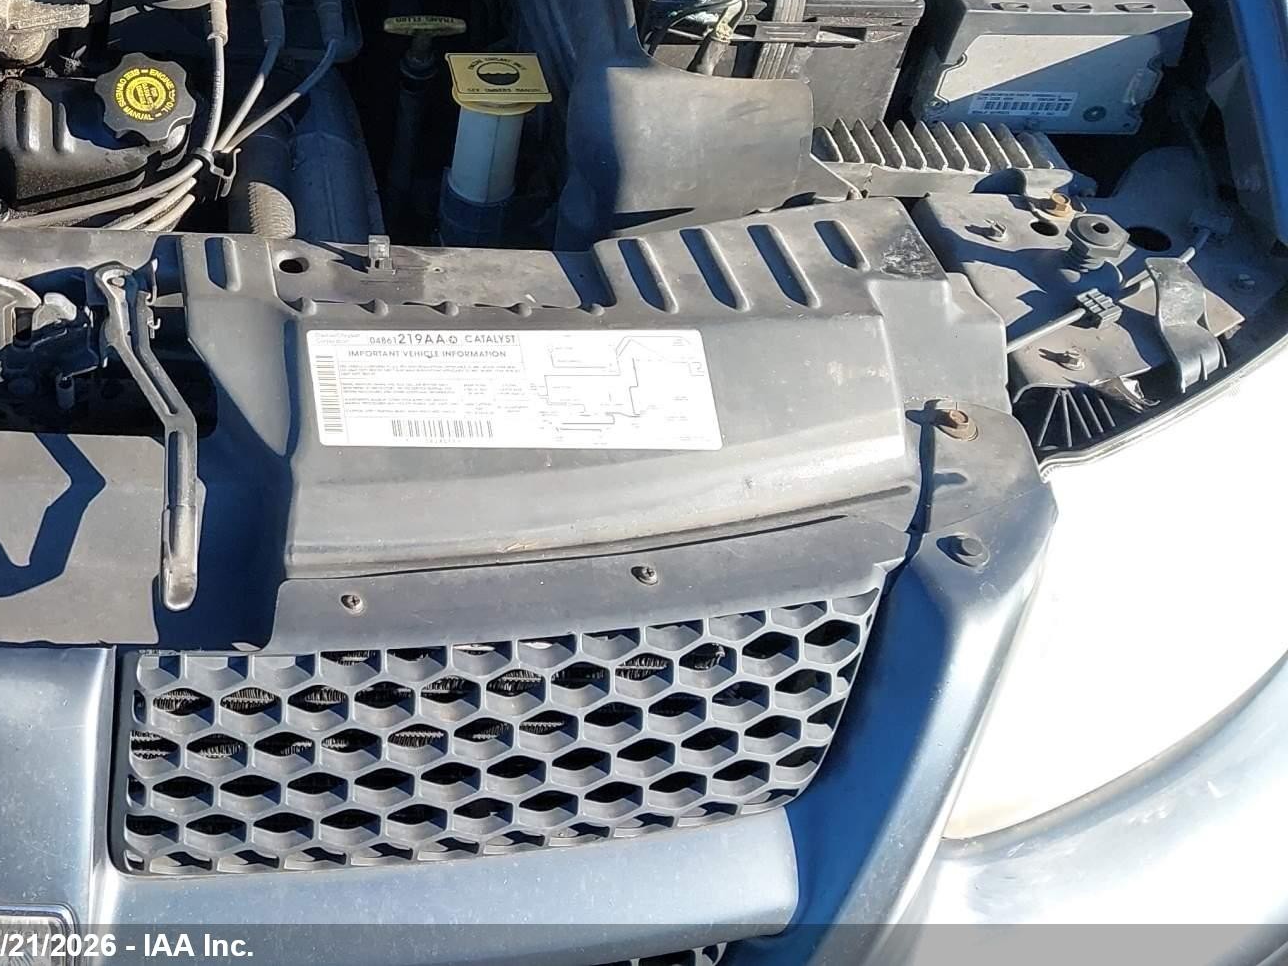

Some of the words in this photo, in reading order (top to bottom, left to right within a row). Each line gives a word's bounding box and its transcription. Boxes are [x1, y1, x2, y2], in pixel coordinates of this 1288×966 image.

[149, 68, 176, 90] ENGINE
[123, 107, 155, 121] MANUAL
[465, 334, 516, 344] CATALYST
[403, 350, 440, 358] VEHICLE
